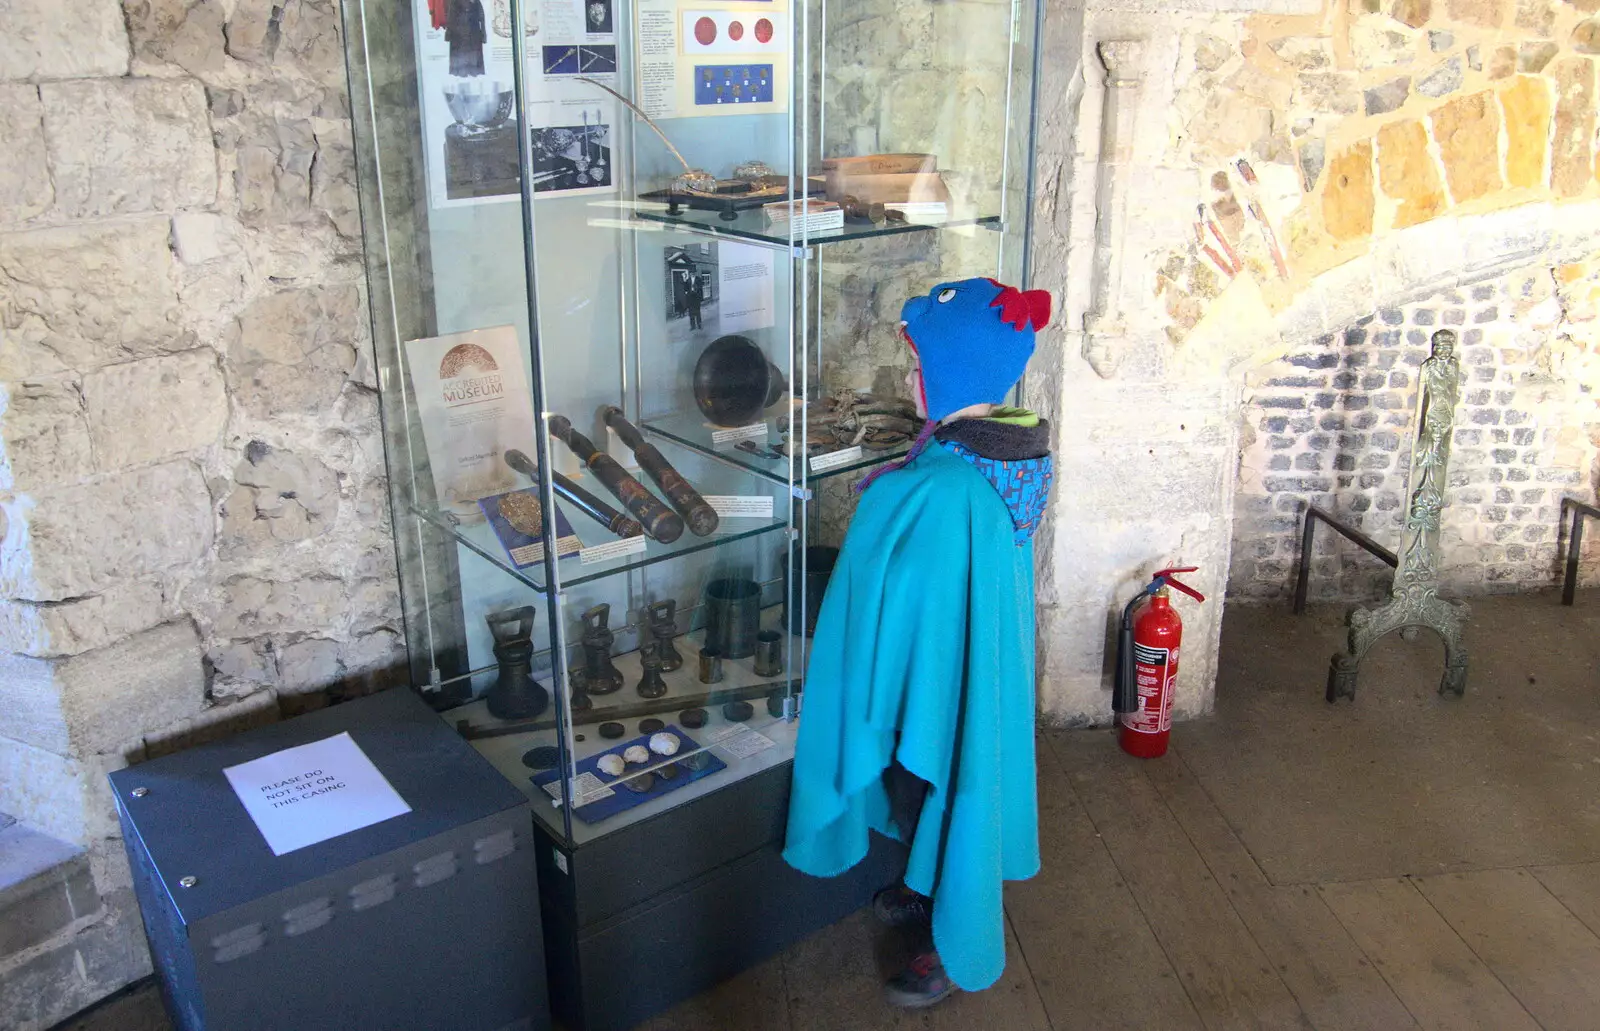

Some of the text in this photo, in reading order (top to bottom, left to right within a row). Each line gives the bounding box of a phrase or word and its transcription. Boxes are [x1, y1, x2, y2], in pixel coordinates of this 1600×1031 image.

[442, 375, 502, 391] ACCREDITED
[443, 383, 503, 402] MUSEUM
[260, 769, 323, 792] PLEASE DO
[266, 775, 335, 801] NOT SIT ON
[272, 782, 346, 809] THIS CASING
